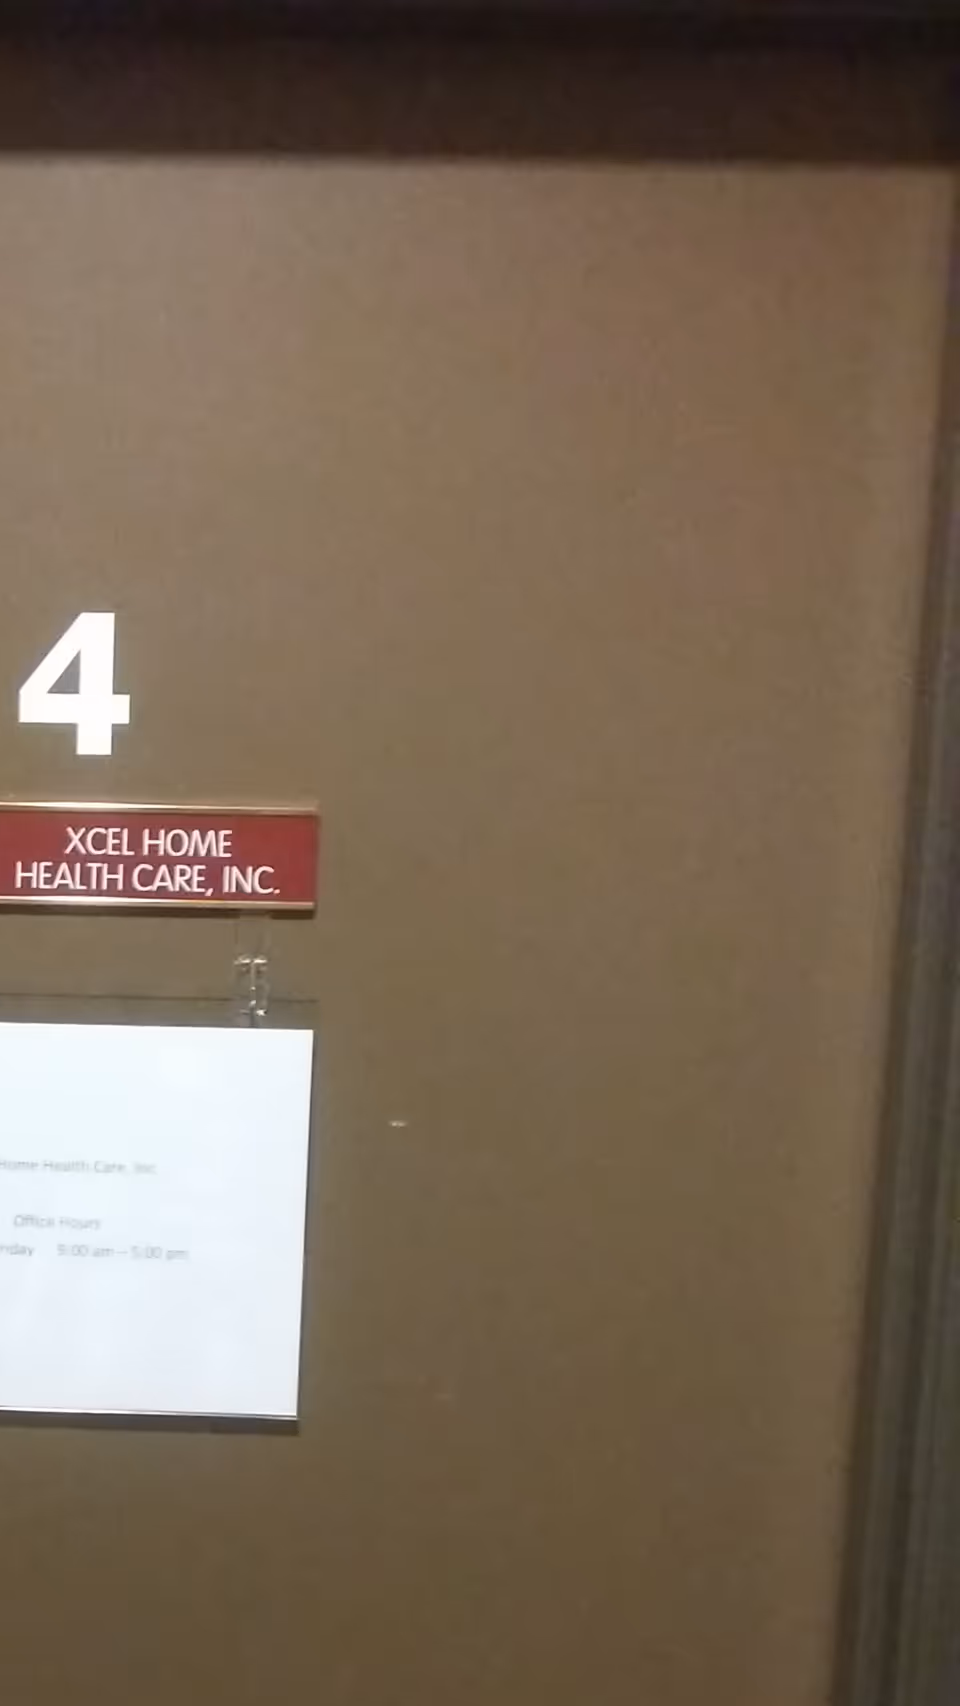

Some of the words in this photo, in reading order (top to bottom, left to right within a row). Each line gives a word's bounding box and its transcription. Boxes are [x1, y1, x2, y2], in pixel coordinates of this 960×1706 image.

[18, 611, 131, 756] 4
[64, 826, 135, 857] XCEL
[142, 828, 233, 858] HOME
[14, 861, 124, 892] HEALTH
[131, 863, 214, 896] CARE,
[222, 865, 281, 895] INC.
[43, 1159, 90, 1172] Health
[13, 1214, 55, 1228] Office
